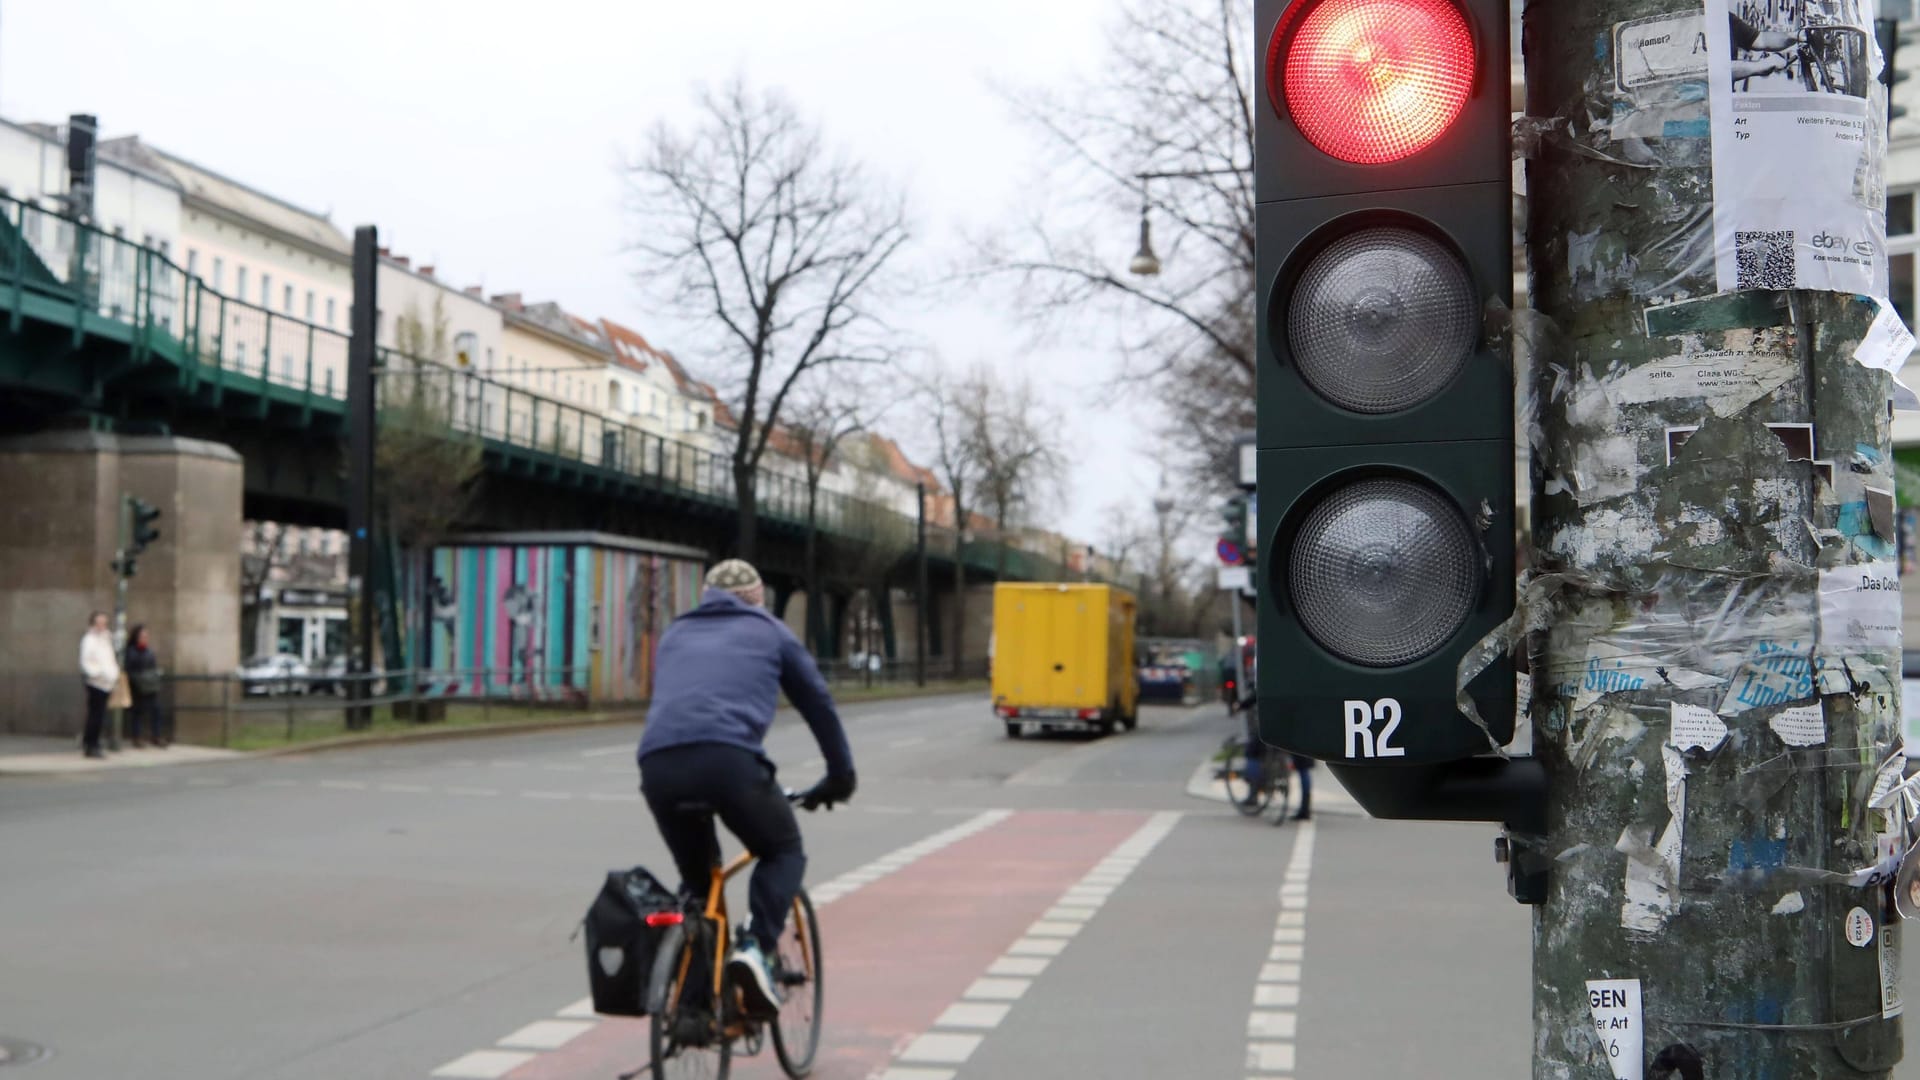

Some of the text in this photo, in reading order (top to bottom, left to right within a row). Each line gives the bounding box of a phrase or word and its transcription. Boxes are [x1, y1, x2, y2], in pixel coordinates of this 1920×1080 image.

[1797, 117, 1824, 125] Weitere
[1735, 131, 1750, 141] Typ
[1812, 231, 1850, 253] ebay
[1649, 370, 1675, 379] seite.
[1344, 698, 1405, 758] R2
[1589, 989, 1627, 1008] GEN
[1610, 1016, 1629, 1030] Art
